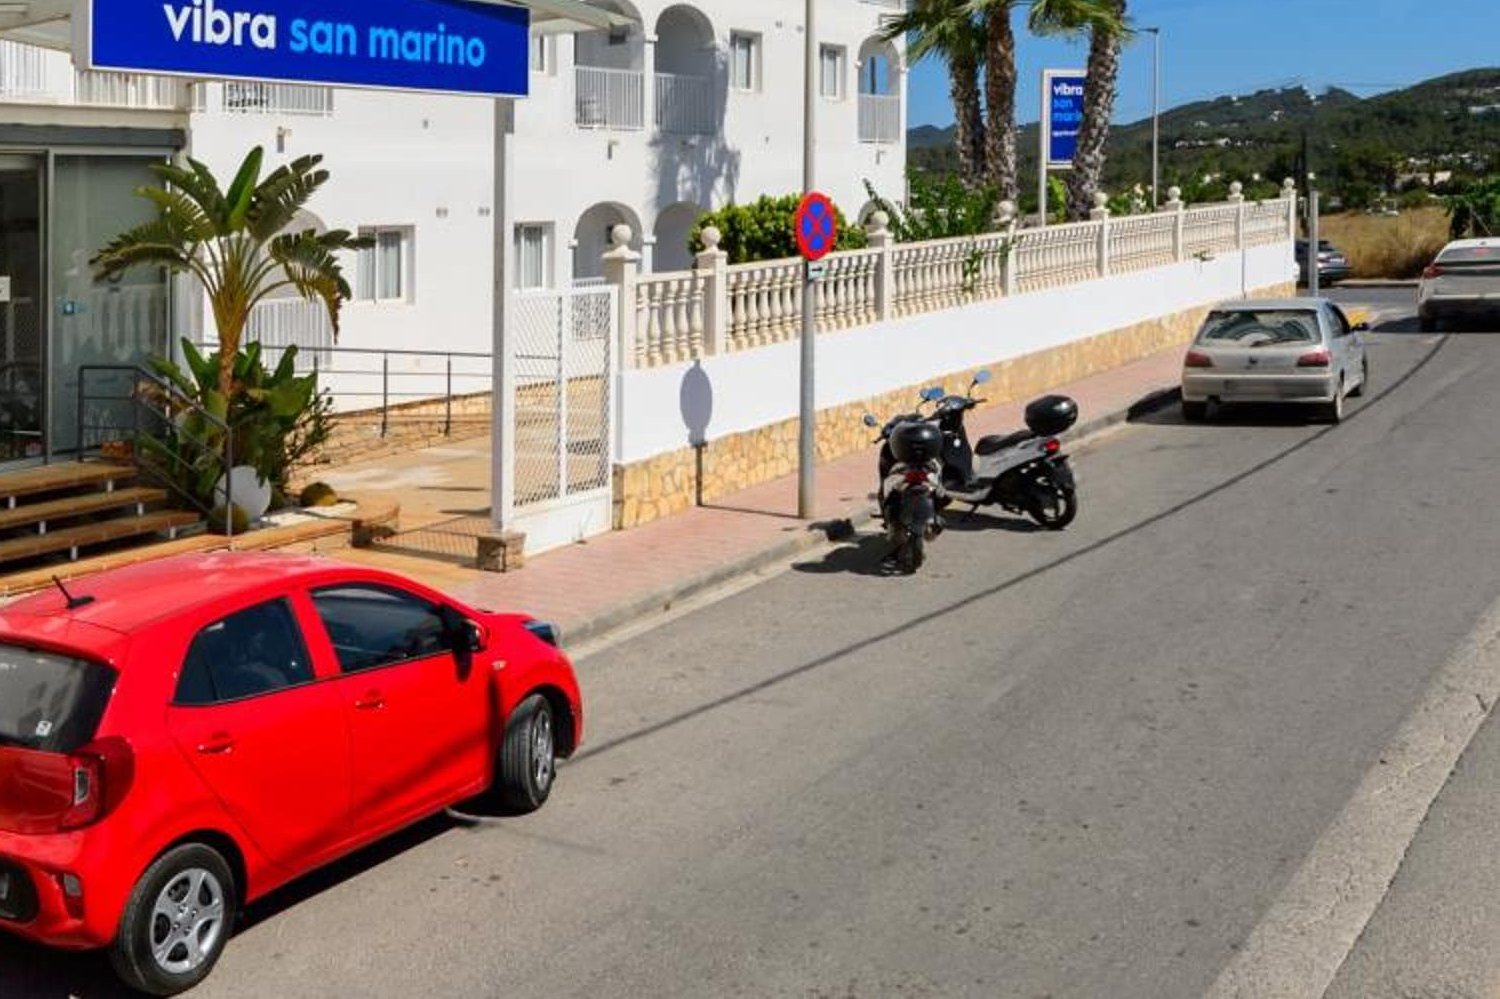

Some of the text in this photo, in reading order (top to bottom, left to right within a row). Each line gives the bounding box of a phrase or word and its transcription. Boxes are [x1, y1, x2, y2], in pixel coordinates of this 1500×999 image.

[290, 18, 357, 56] san
[368, 22, 486, 68] marino
[1053, 82, 1084, 96] vibra
[1053, 98, 1074, 109] san
